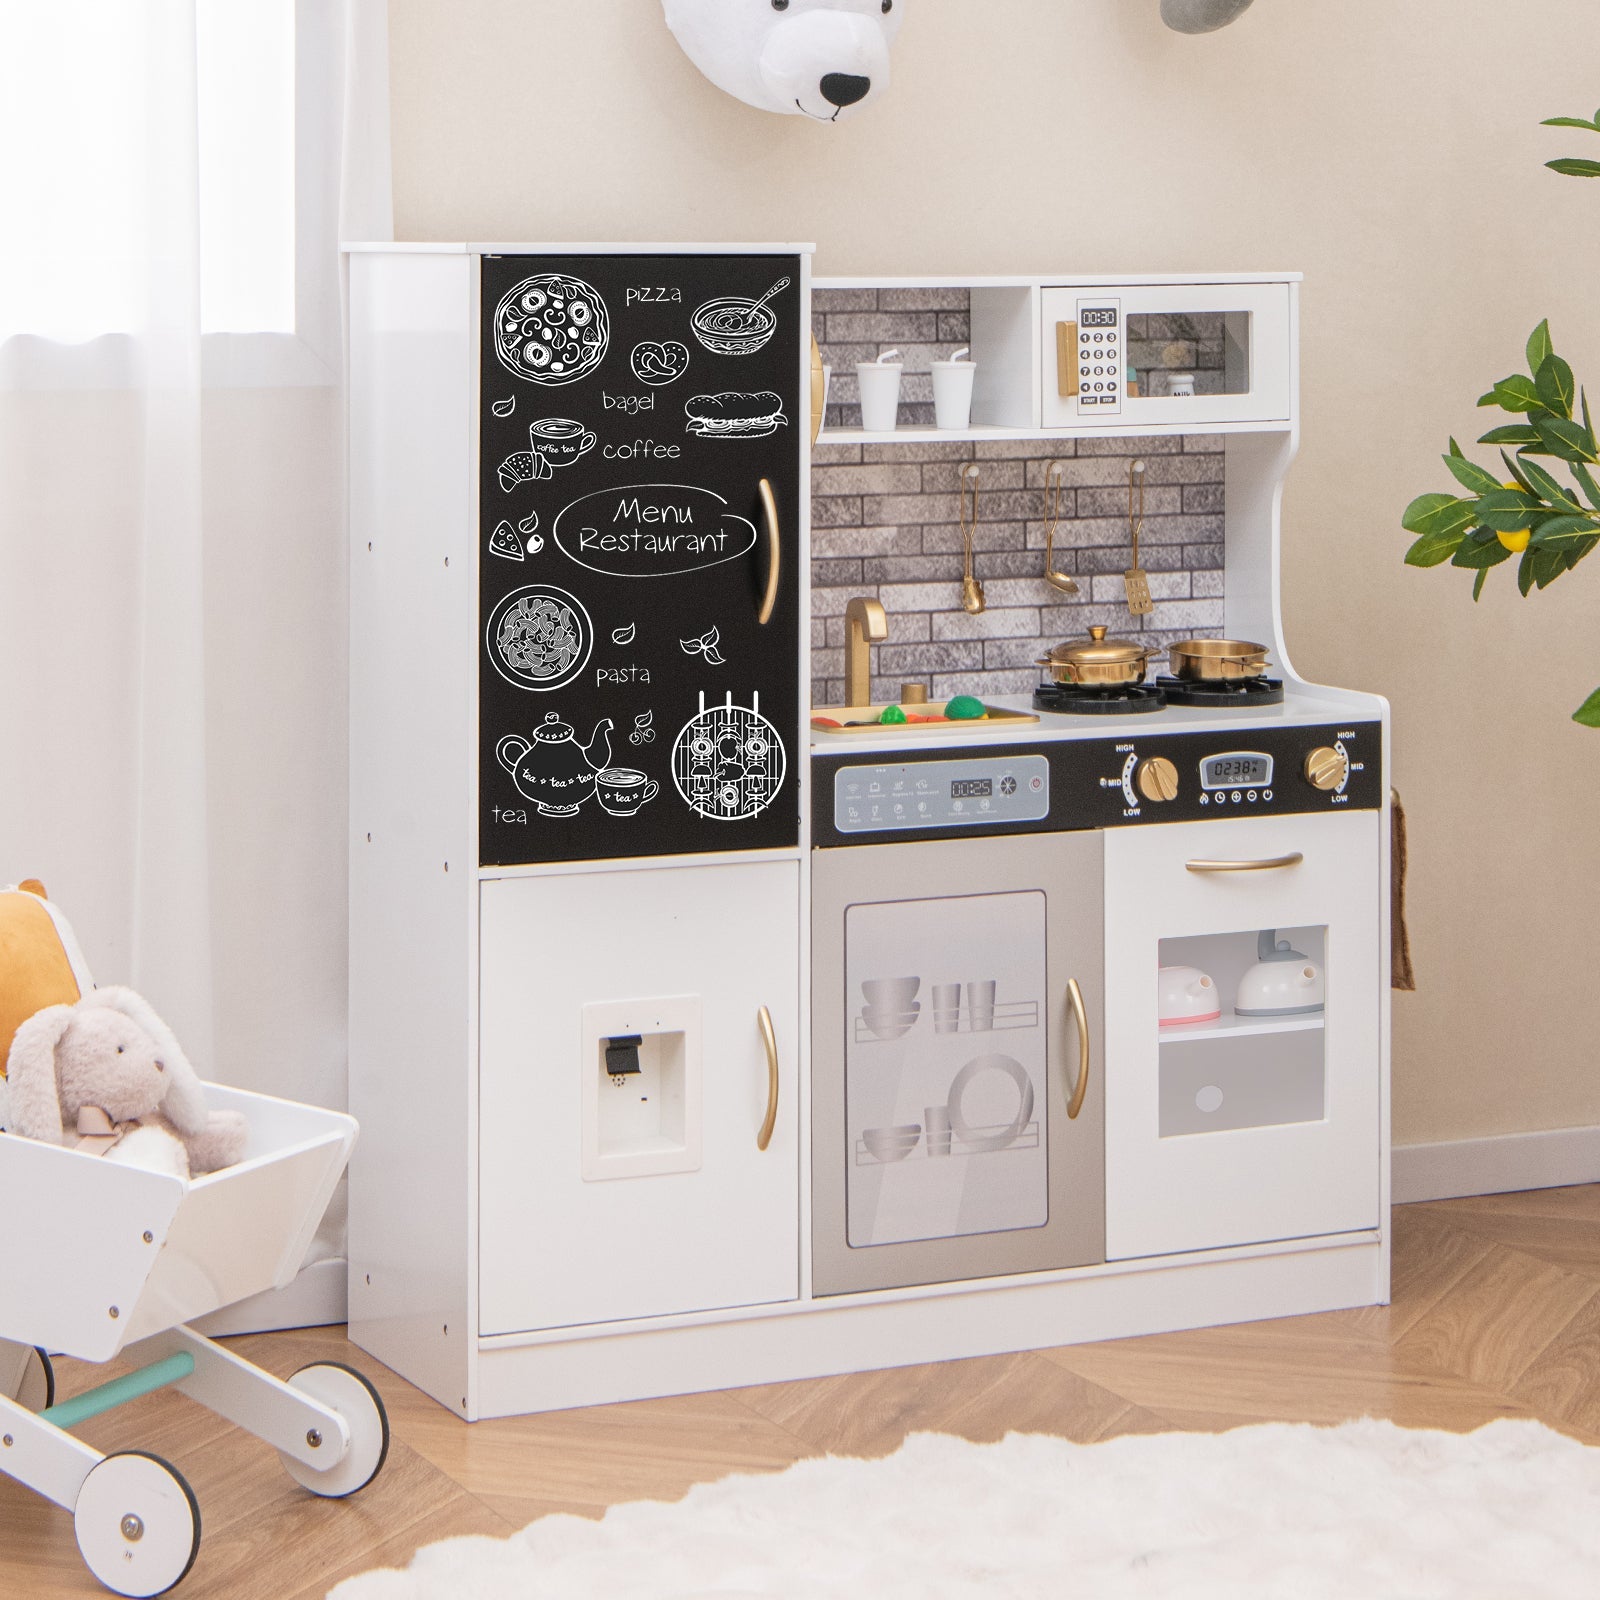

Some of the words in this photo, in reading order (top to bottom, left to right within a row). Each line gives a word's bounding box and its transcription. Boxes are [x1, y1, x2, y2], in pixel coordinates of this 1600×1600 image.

[626, 285, 682, 306] pizza
[1083, 311, 1114, 324] 00:30
[602, 391, 654, 415] bagel
[537, 443, 560, 454] coffee
[560, 444, 576, 453] tea
[602, 439, 681, 460] coffee
[612, 497, 693, 524] Menu
[579, 528, 728, 553] Restaurant
[597, 664, 650, 687] pasta
[1337, 731, 1356, 739] HIGH
[1115, 744, 1135, 752] HIGH
[1214, 761, 1250, 776] 0238
[522, 768, 537, 783] tea
[549, 776, 568, 788] tea
[576, 773, 595, 784] tea
[1108, 778, 1122, 787] MID
[613, 791, 632, 803] tea
[953, 781, 989, 797] 00:25
[1331, 795, 1348, 803] LOW
[491, 805, 527, 825] tea
